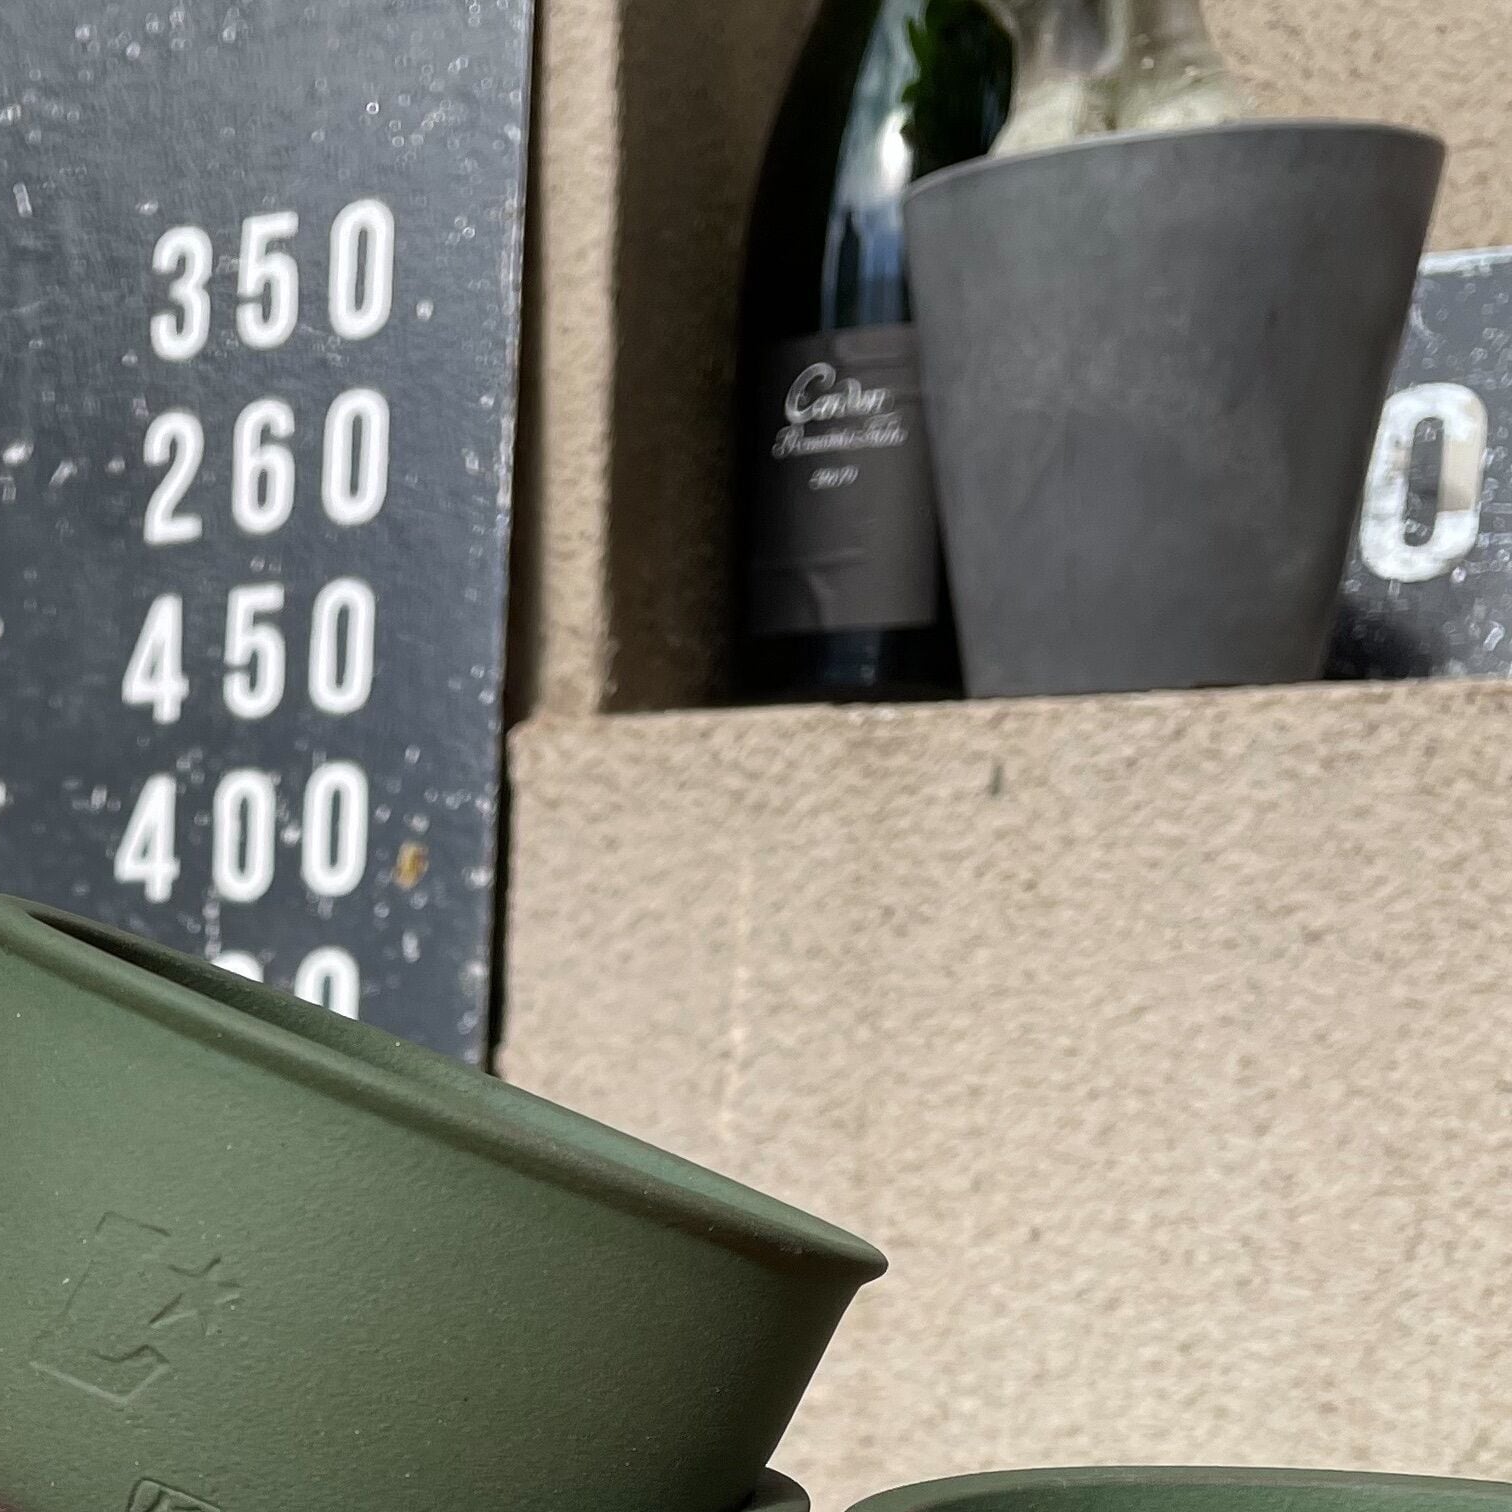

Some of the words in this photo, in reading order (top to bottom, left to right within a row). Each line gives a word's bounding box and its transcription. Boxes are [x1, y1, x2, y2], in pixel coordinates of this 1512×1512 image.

[149, 195, 396, 363] 350
[142, 386, 390, 546] 260
[121, 576, 376, 724] 450
[113, 760, 369, 904] 400
